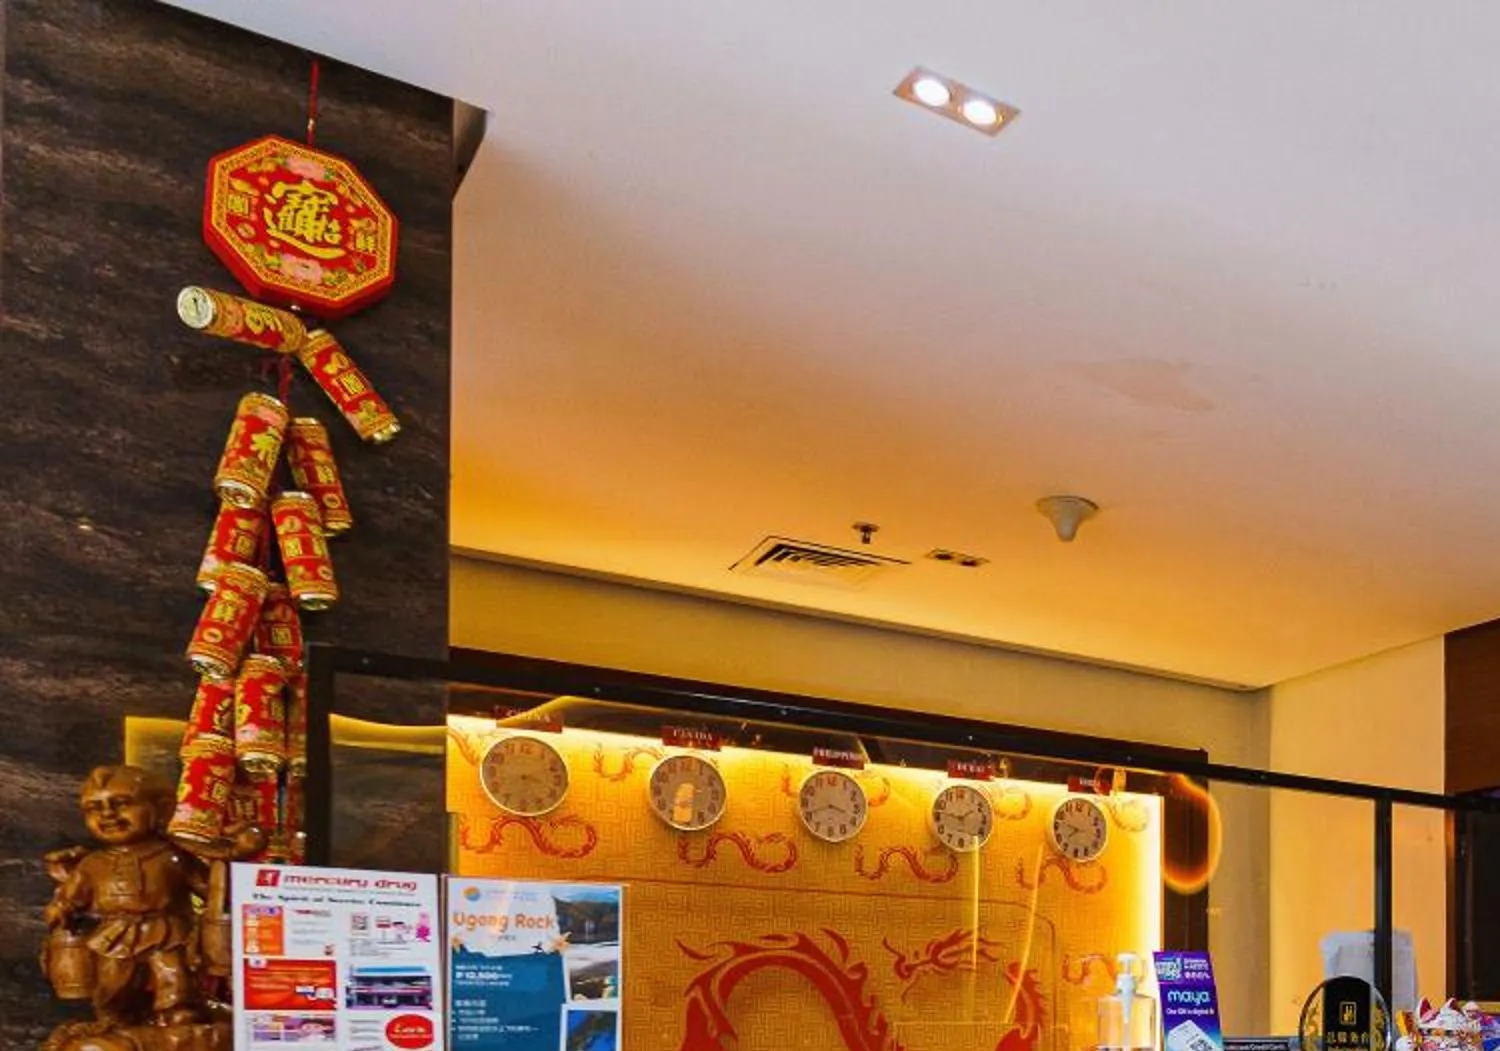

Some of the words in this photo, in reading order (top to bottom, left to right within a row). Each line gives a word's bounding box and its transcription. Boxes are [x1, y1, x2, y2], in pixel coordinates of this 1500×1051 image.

[284, 874, 369, 888] mercury
[375, 877, 417, 891] drug
[515, 913, 555, 929] Rock
[1167, 990, 1211, 1006] maya
